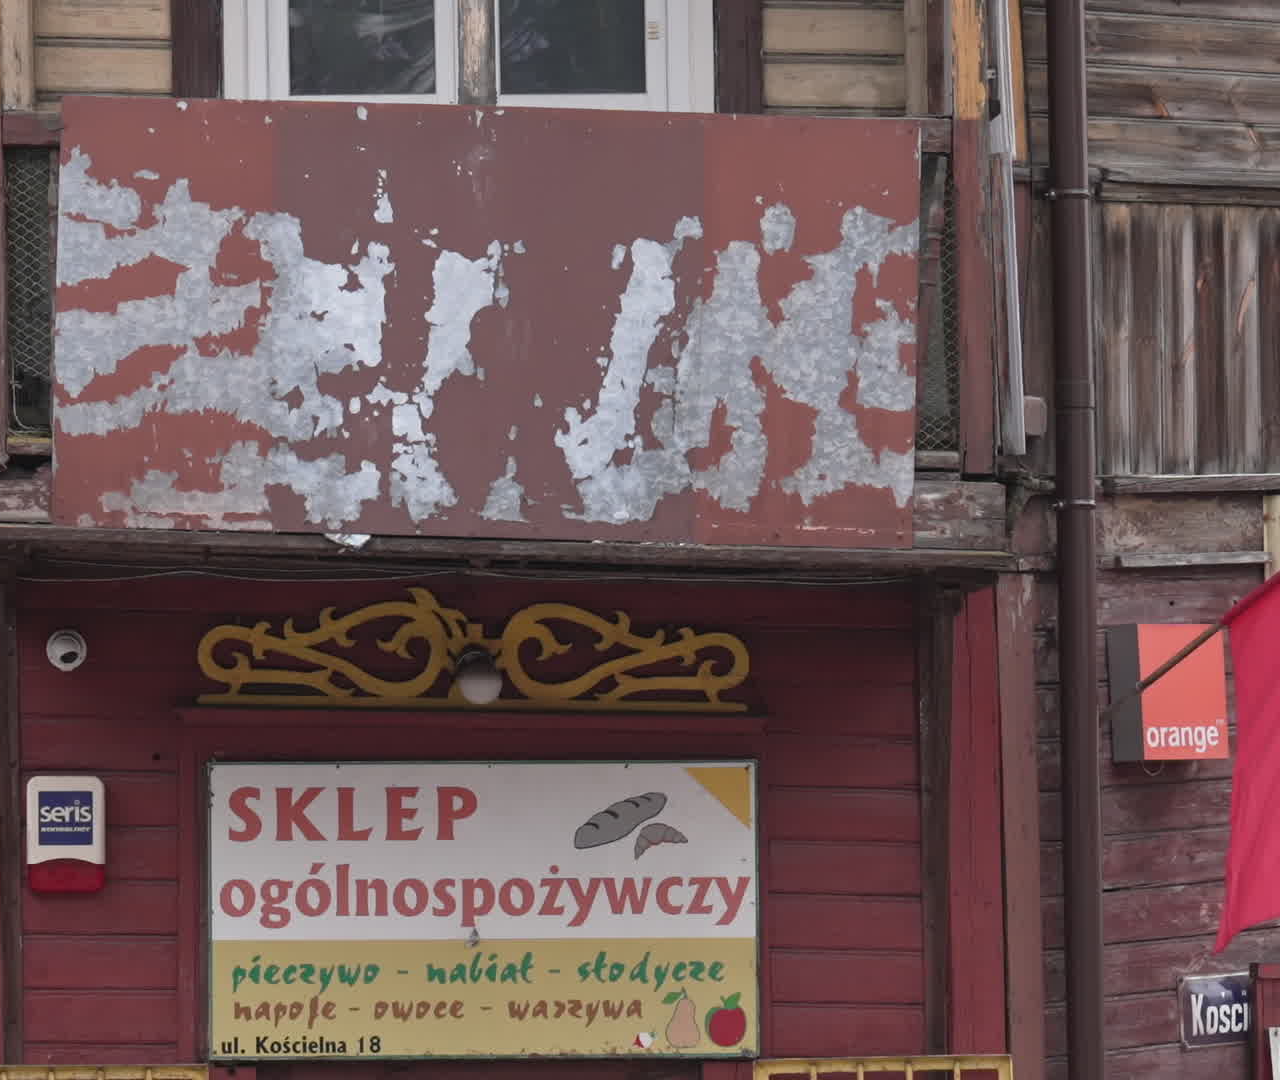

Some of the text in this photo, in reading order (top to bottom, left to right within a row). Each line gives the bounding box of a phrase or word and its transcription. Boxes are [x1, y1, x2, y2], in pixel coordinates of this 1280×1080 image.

[1146, 726, 1219, 753] orange
[40, 800, 92, 823] seris
[228, 786, 478, 842] SKLEP
[220, 863, 751, 928] ogólnospożywczy
[231, 955, 381, 993] pieczywo
[426, 952, 536, 985] nabiał
[577, 951, 725, 993] słodycze
[233, 994, 337, 1029] napoje
[373, 999, 465, 1023] owoce
[507, 999, 644, 1028] warzywa
[1191, 990, 1248, 1036] Kości
[221, 1035, 382, 1054] ul. Kościelna 18
